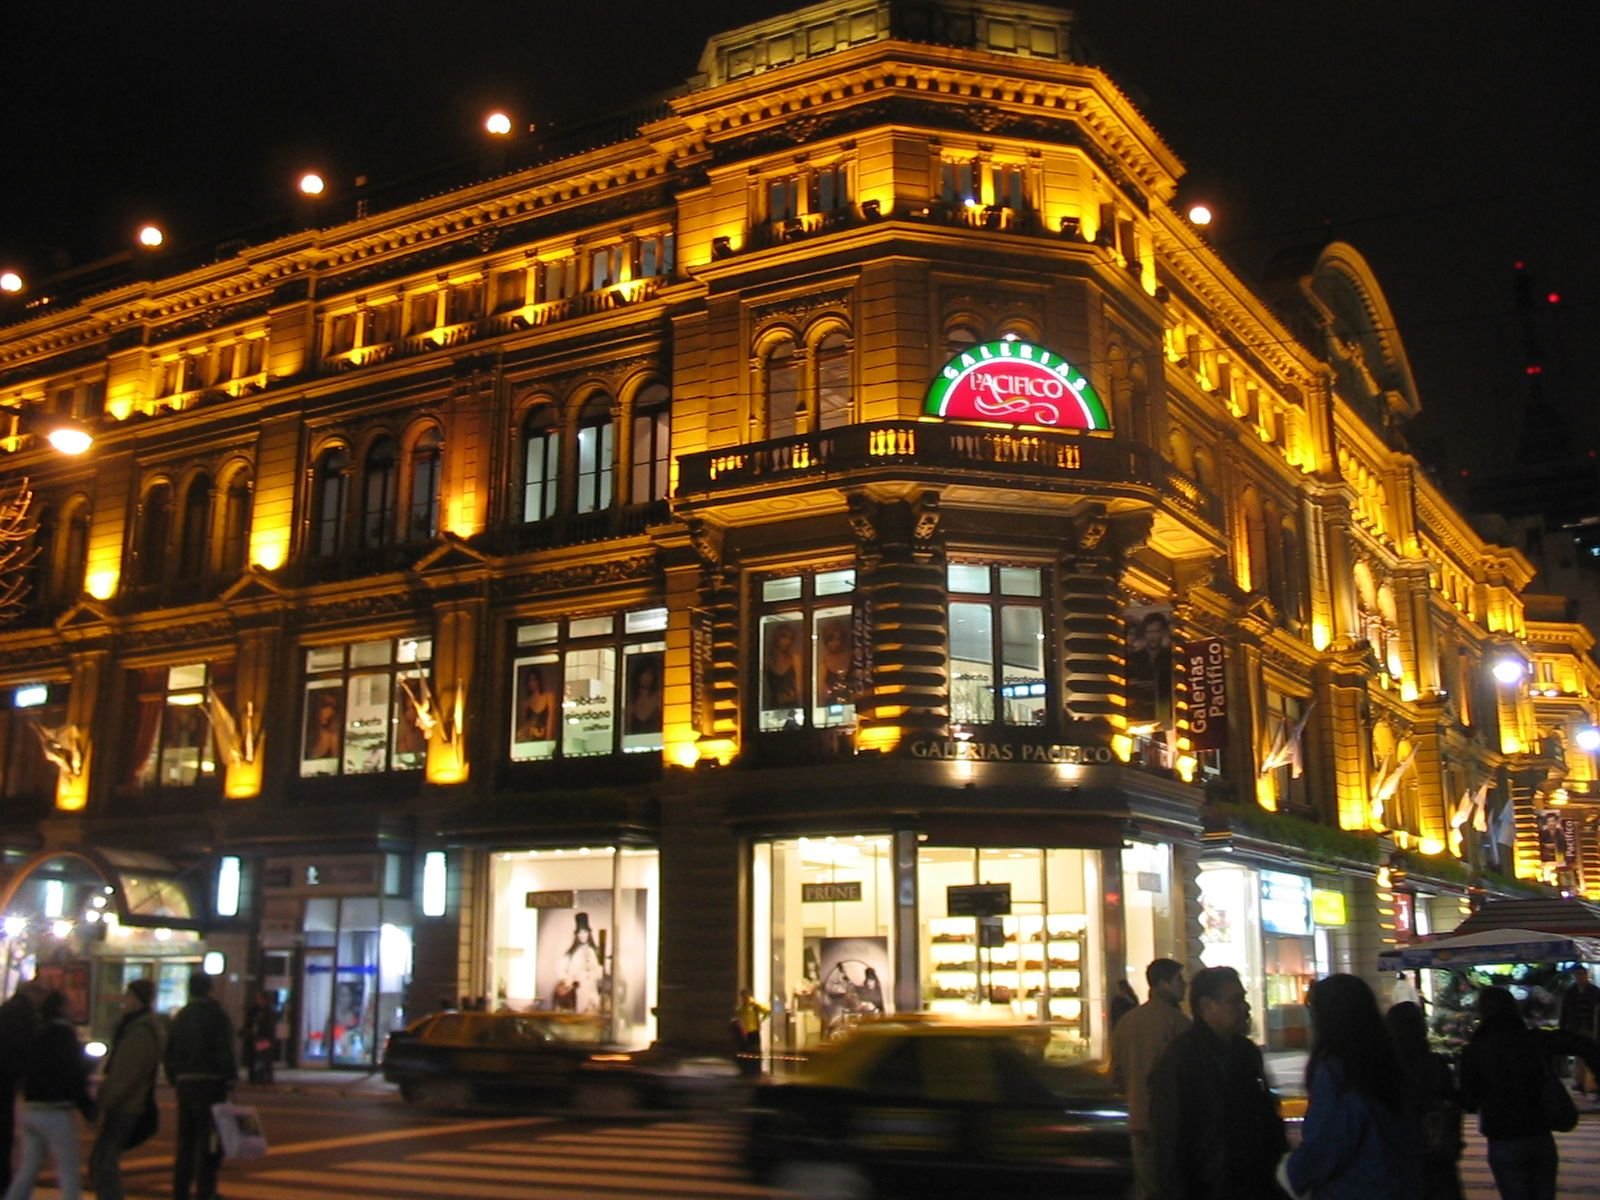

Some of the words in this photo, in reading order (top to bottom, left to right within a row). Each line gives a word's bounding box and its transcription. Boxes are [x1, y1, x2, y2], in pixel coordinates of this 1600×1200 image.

[943, 343, 1088, 391] GALERIAS
[970, 371, 1064, 402] PACIFICO
[702, 619, 713, 662] Mall
